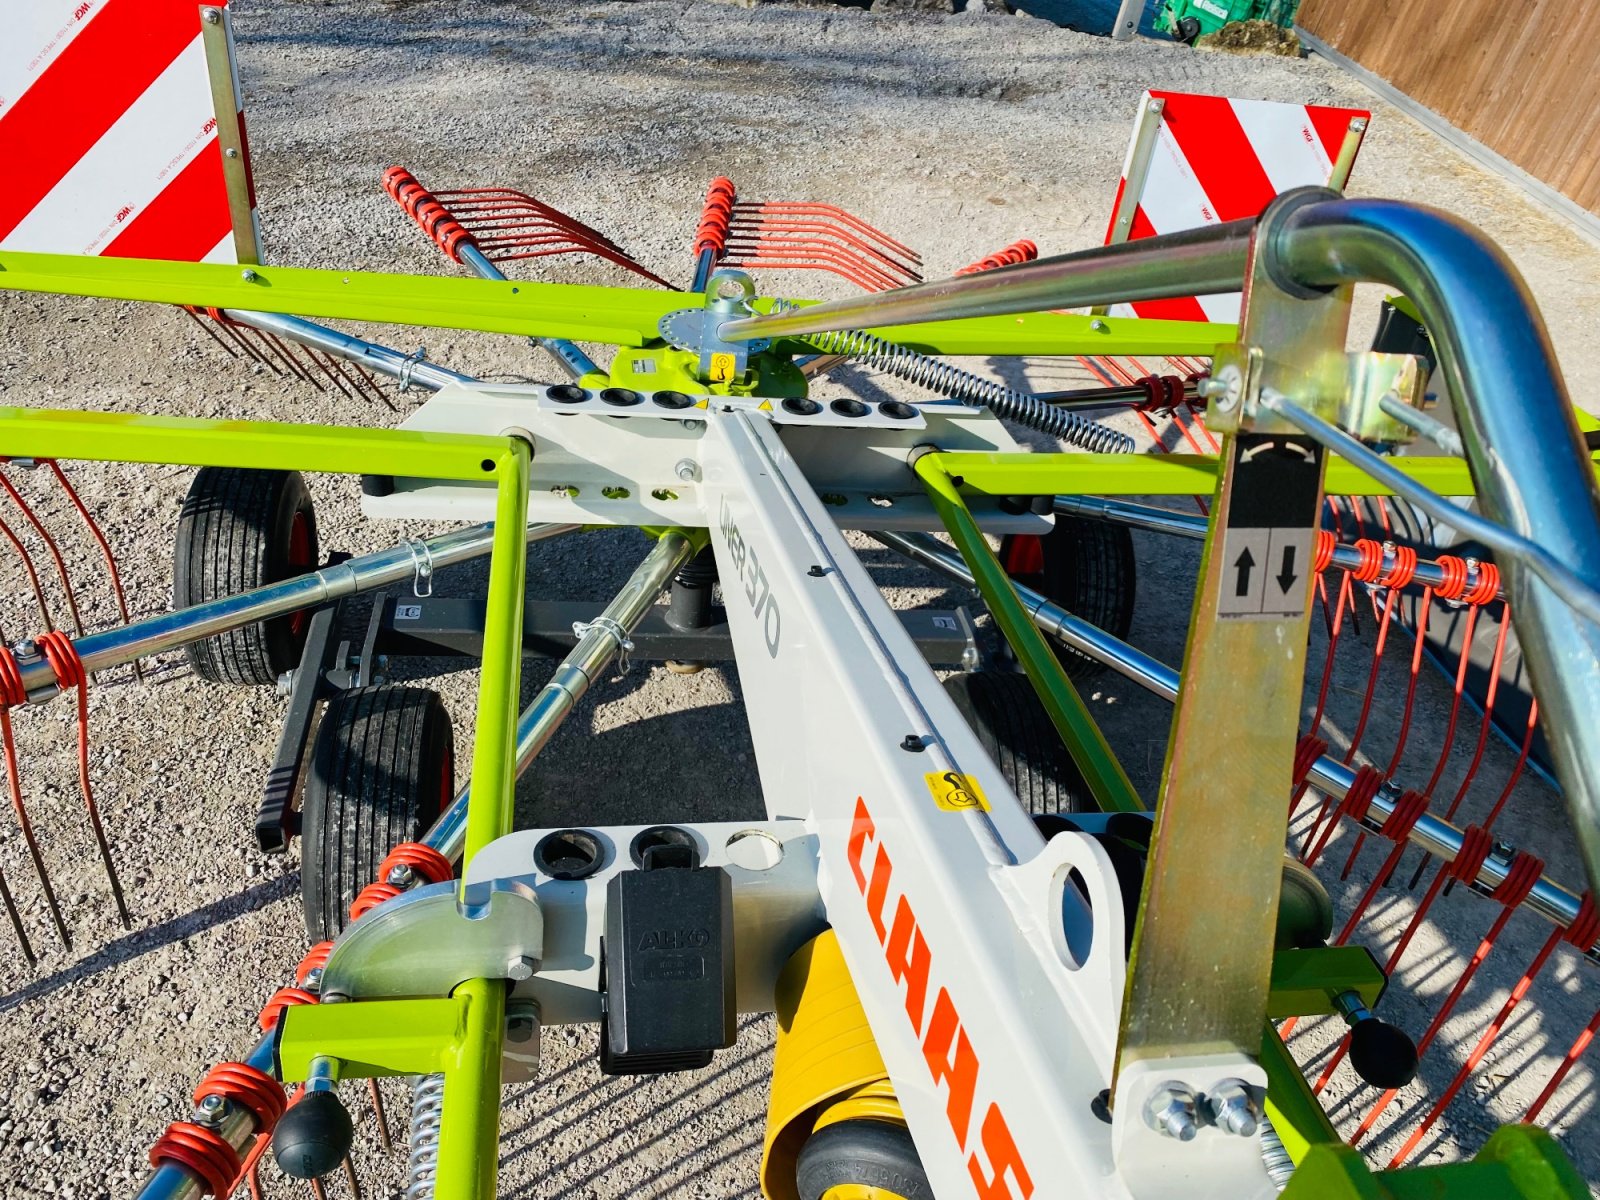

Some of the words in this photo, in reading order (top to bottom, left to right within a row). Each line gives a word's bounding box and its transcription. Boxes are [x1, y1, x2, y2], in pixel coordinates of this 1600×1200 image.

[74, 2, 91, 21] WGF
[203, 118, 217, 135] WGF
[1302, 128, 1313, 142] WGF
[117, 207, 131, 223] WGF
[1202, 207, 1213, 220] WGF
[745, 545, 781, 659] 370
[847, 795, 1035, 1200] CLAAS
